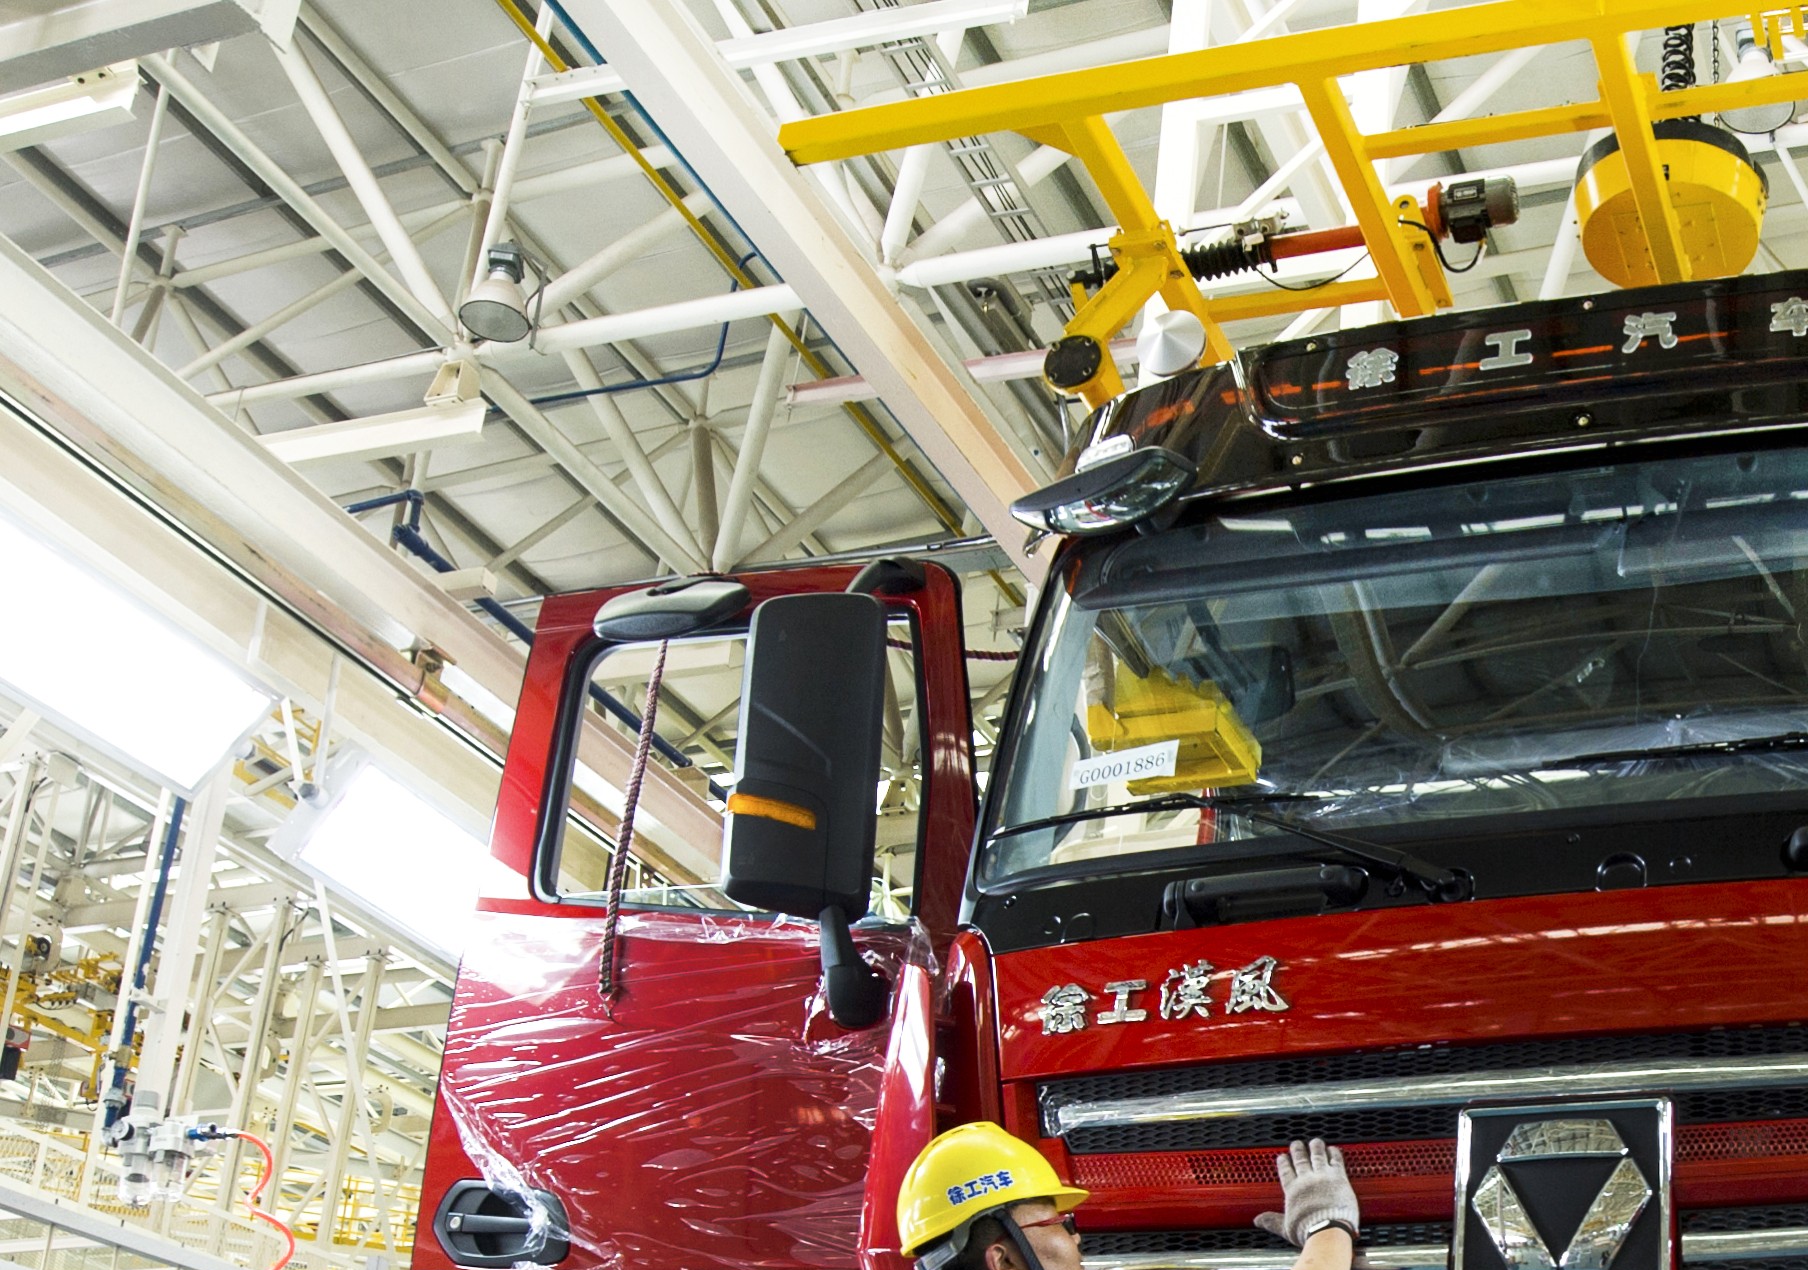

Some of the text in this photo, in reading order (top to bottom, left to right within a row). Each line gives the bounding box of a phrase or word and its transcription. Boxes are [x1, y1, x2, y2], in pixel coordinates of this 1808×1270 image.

[1079, 752, 1165, 784] G0001886
[947, 1171, 1014, 1205] 徐工汽车
